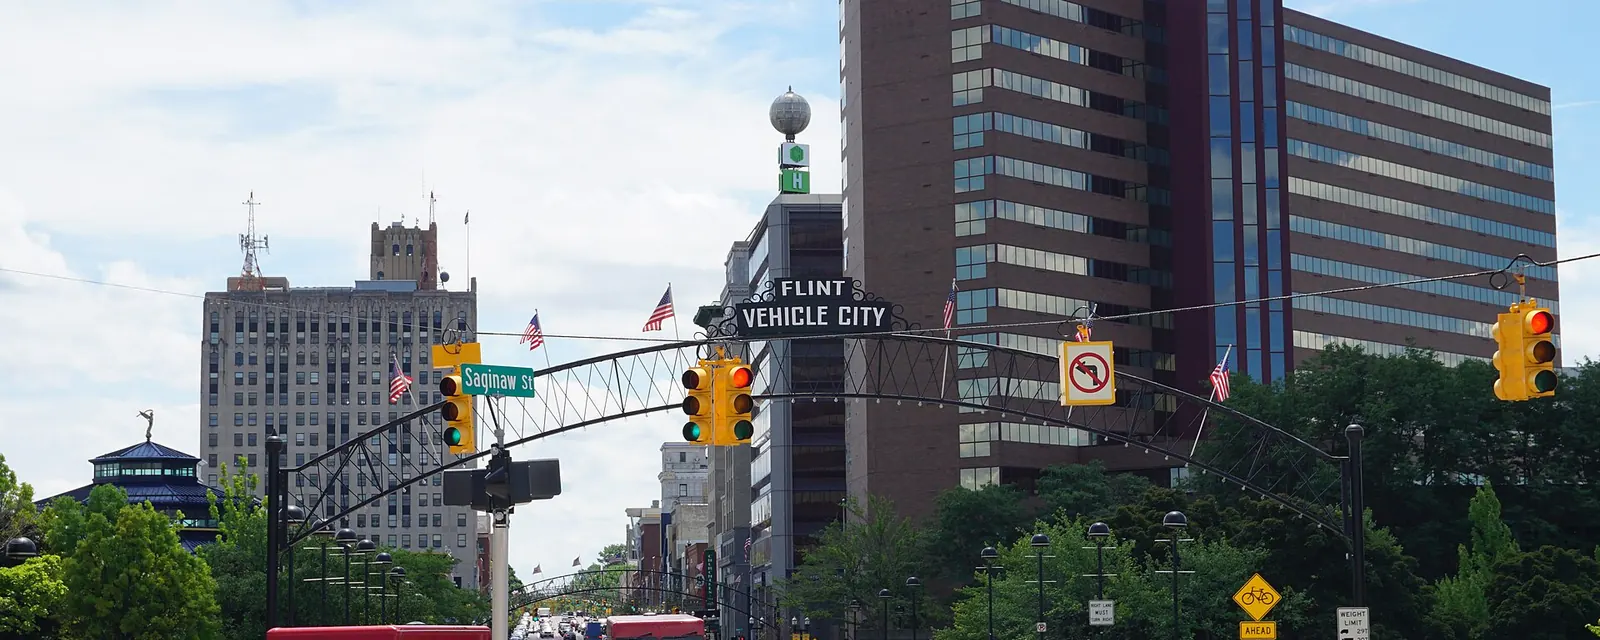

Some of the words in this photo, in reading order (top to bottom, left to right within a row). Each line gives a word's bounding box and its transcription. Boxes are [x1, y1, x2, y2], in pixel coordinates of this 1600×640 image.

[792, 172, 803, 190] H
[781, 280, 845, 297] FLINT
[742, 306, 828, 328] VEHICLE
[838, 306, 886, 327] CITY
[465, 367, 516, 394] Saginaw
[521, 374, 533, 390] St
[1245, 626, 1272, 635] AHEAD
